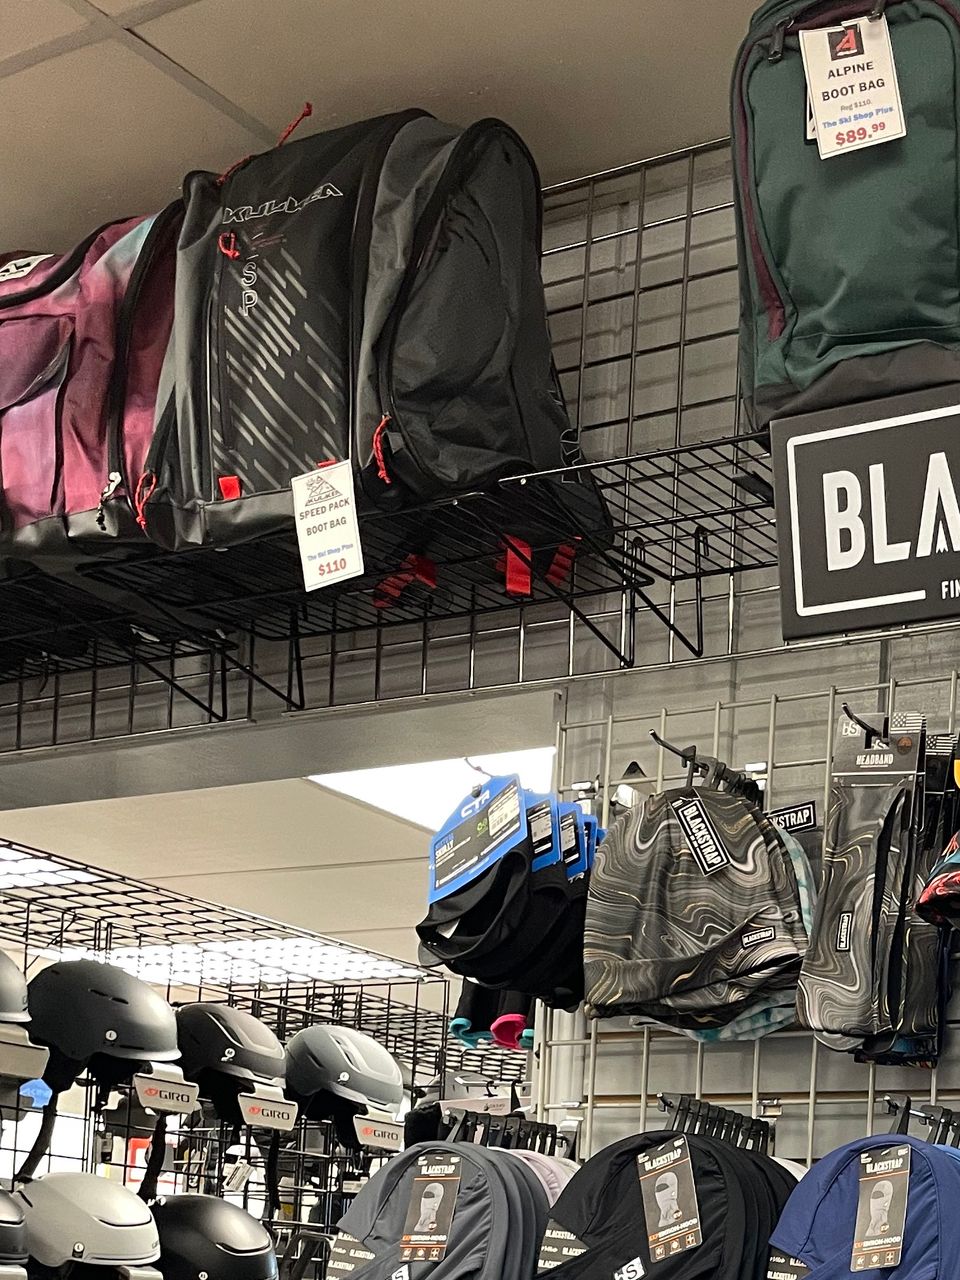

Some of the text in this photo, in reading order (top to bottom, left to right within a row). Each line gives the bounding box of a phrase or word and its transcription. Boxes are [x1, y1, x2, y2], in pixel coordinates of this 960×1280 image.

[827, 61, 874, 79] ALPINE
[821, 78, 885, 101] BOOT BAG
[822, 106, 894, 129] The Ski Shop Plus
[835, 121, 886, 147] $89.99
[300, 497, 350, 520] SPEED PACK
[306, 516, 347, 536] BOOT BAG
[318, 558, 347, 576] $110
[856, 754, 894, 766] HEADBAND
[683, 805, 722, 866] BLACKSTRAP
[839, 915, 849, 949] BLACKSTRAP
[158, 1089, 191, 1103] GIRO
[260, 1107, 291, 1121] GIRO
[368, 1128, 399, 1141] GIRO
[421, 1164, 456, 1175] BLACKSTRAP
[644, 1148, 682, 1172] BLACKSTRAP
[866, 1158, 903, 1174] BLACKSTRAP
